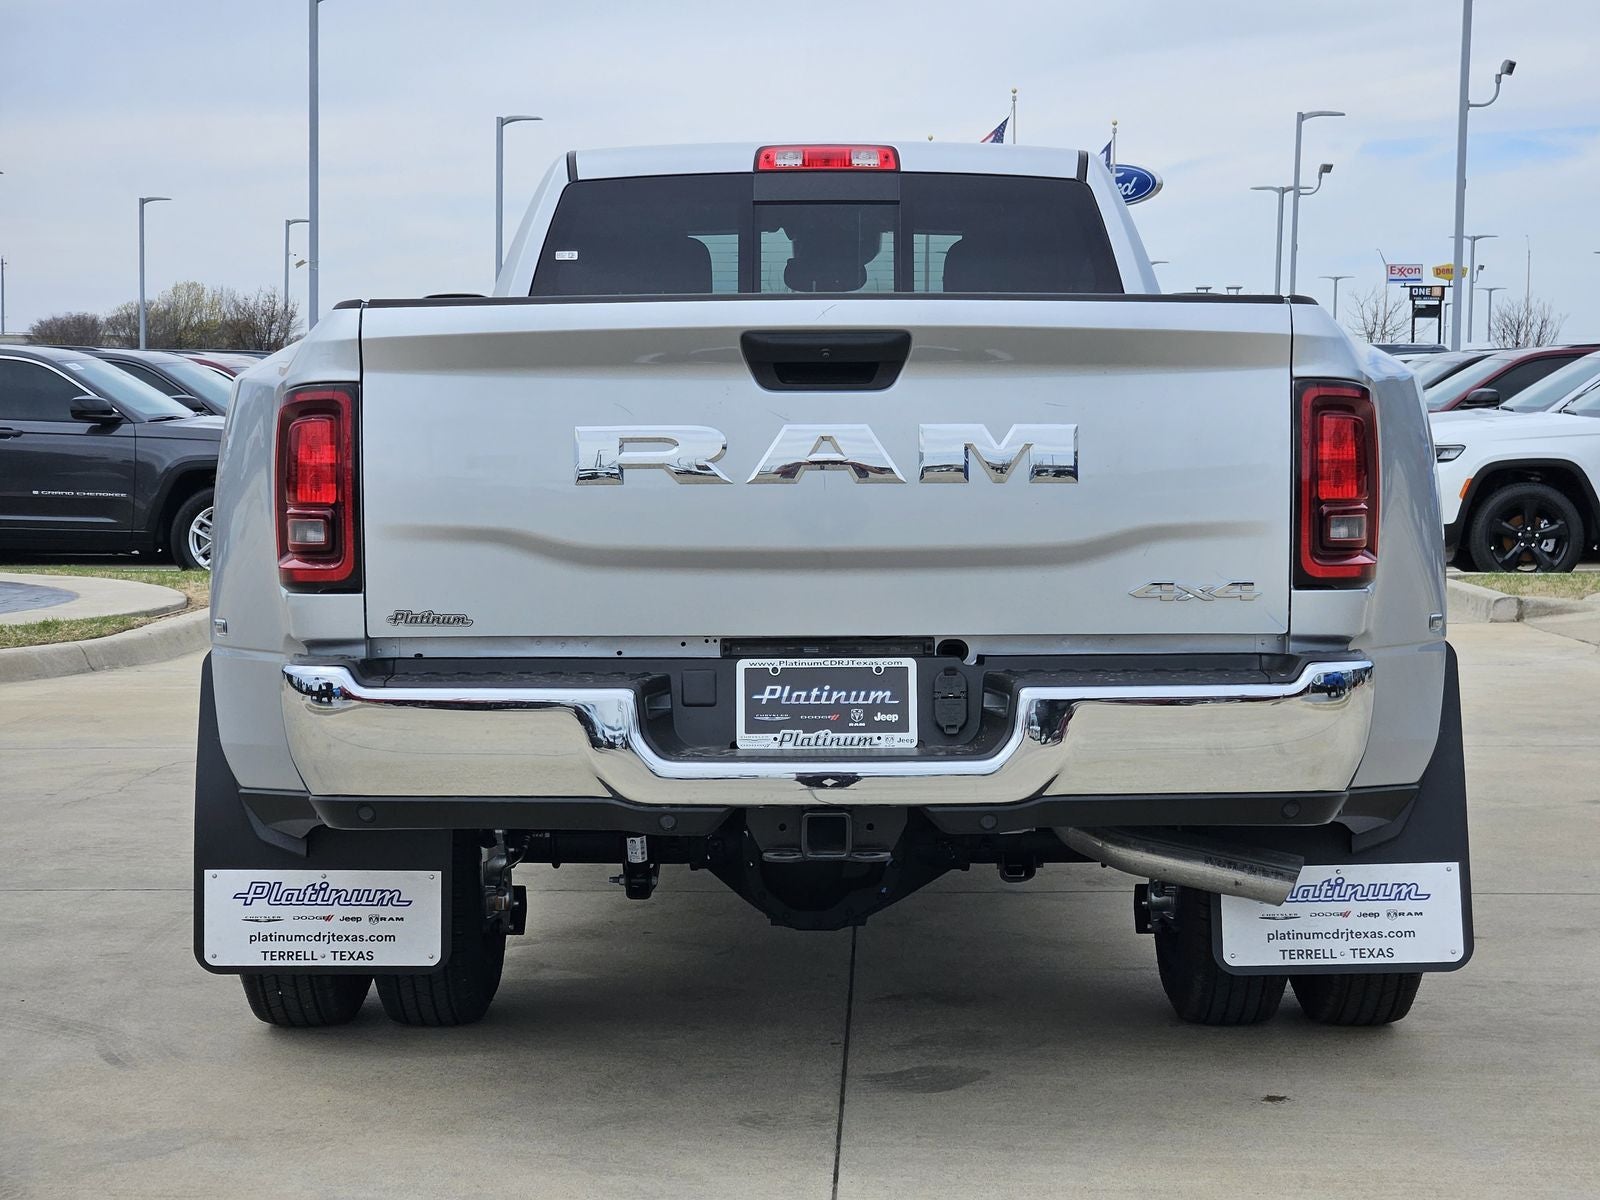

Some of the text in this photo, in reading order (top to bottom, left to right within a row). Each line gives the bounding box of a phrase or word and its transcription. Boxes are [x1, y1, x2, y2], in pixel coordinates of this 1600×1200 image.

[1390, 266, 1420, 277] Exxon
[575, 423, 1079, 486] RAM
[386, 610, 474, 628] Platinum
[748, 659, 903, 667] www.PlatinumCDRJTexas.com
[752, 685, 900, 704] Platinum
[873, 712, 899, 722] Jeep
[778, 732, 881, 747] Platinum
[233, 881, 413, 907] Platinum
[339, 914, 363, 923] Jeep
[1356, 911, 1380, 920] Jeep
[249, 932, 396, 944] platinumcdrjtexas.com
[1266, 929, 1416, 943] platinumcdrjtexas.com
[261, 951, 375, 961] TERRELL TEXAS
[1279, 947, 1395, 960] TERRELL TEXAS
